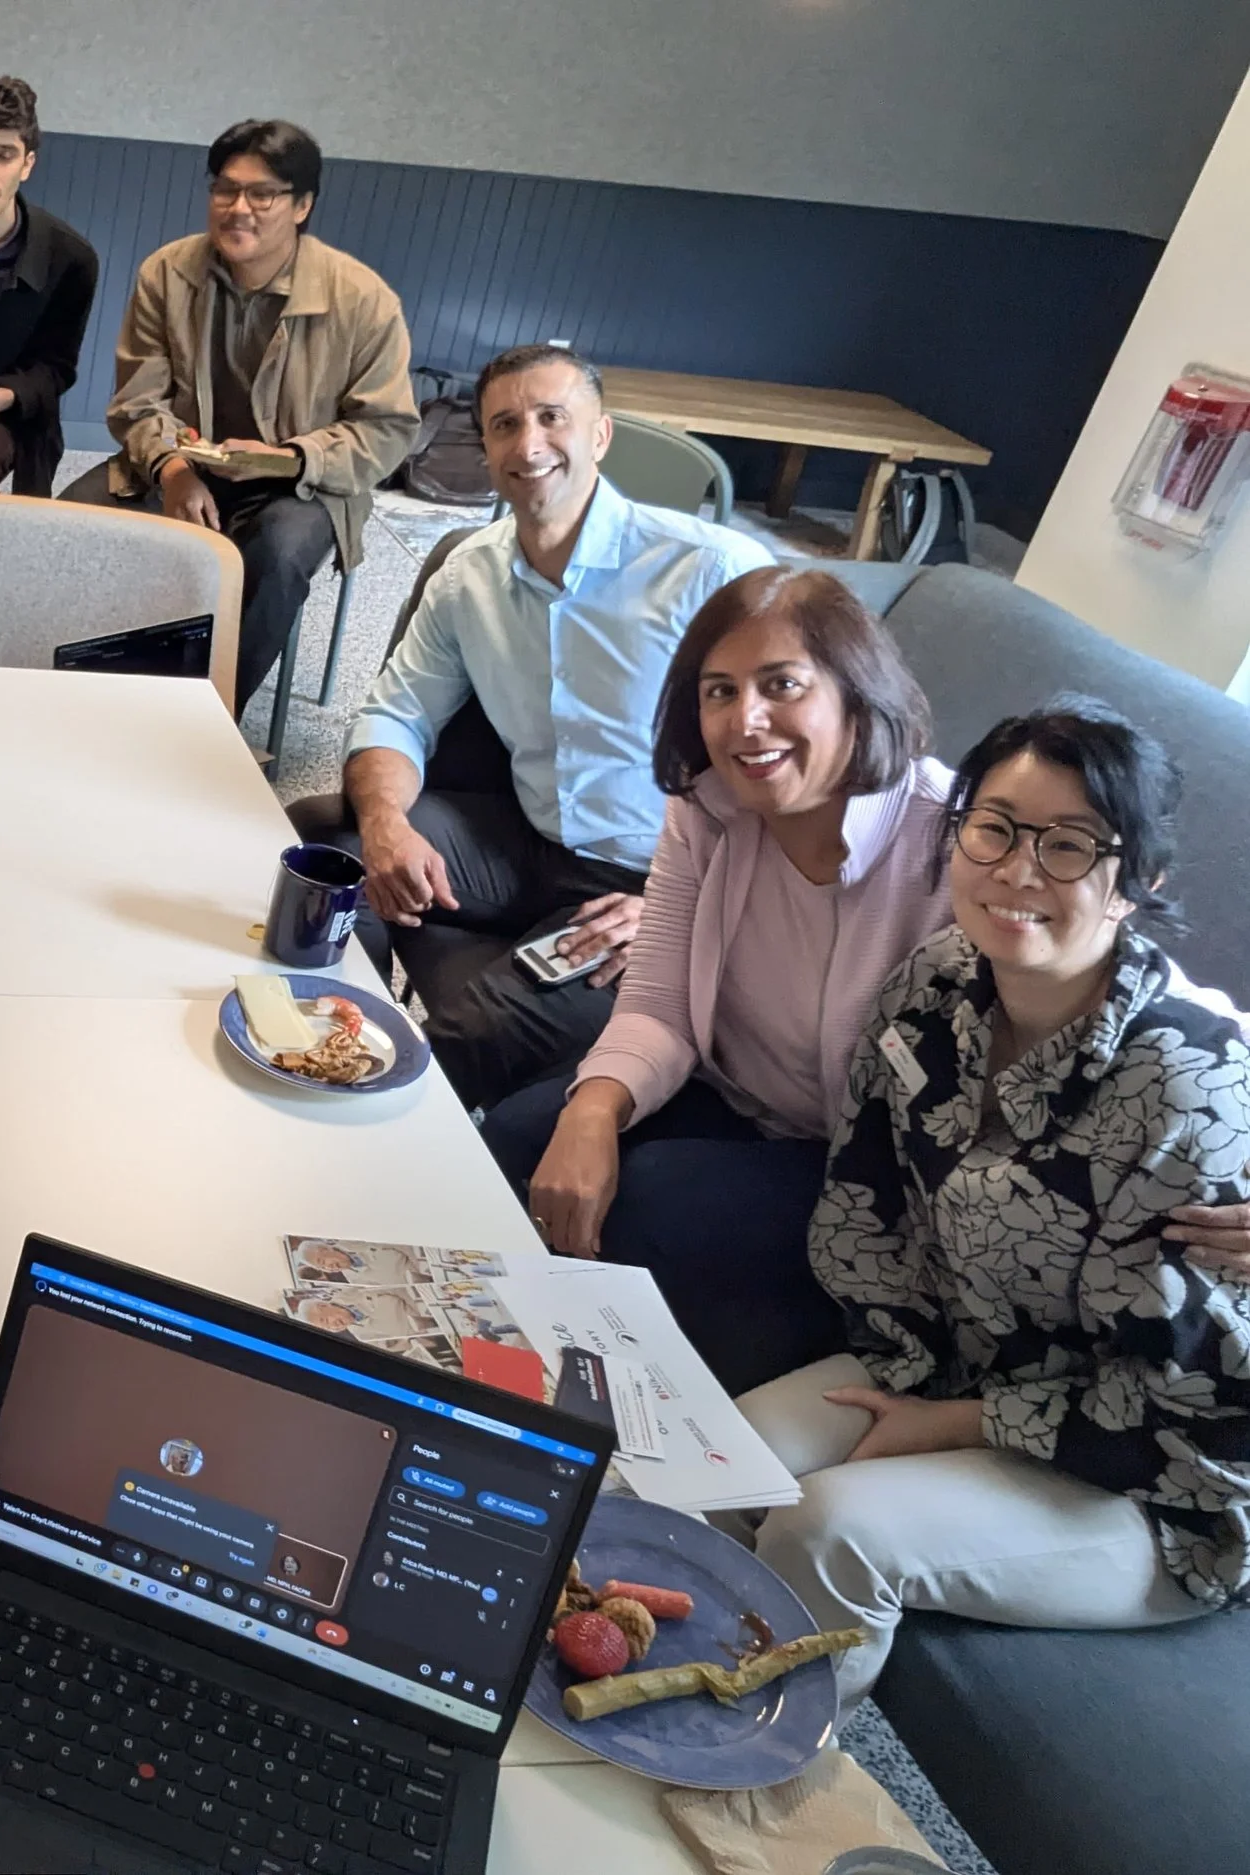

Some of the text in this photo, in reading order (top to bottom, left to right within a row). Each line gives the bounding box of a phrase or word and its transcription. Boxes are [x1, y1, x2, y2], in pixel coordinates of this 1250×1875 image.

[49, 1286, 59, 1296] You
[60, 1290, 71, 1300] lost
[71, 1294, 84, 1304] your
[83, 1298, 106, 1312] network
[138, 1317, 156, 1330] Trying
[156, 1323, 163, 1331] to
[413, 1444, 440, 1460] People
[432, 1479, 455, 1492] muted
[136, 1486, 197, 1513] Camera unavailable
[413, 1499, 474, 1526] Search for people
[498, 1501, 537, 1519] Add people
[119, 1494, 254, 1549] Close other apps that might be using your camera
[69, 1528, 77, 1536] of
[77, 1531, 102, 1546] Service
[229, 1551, 255, 1567] Try again
[386, 1530, 503, 1577] Contributors 2
[402, 1557, 418, 1568] Erica
[418, 1562, 436, 1575] Frank,
[463, 1579, 481, 1592] (You)
